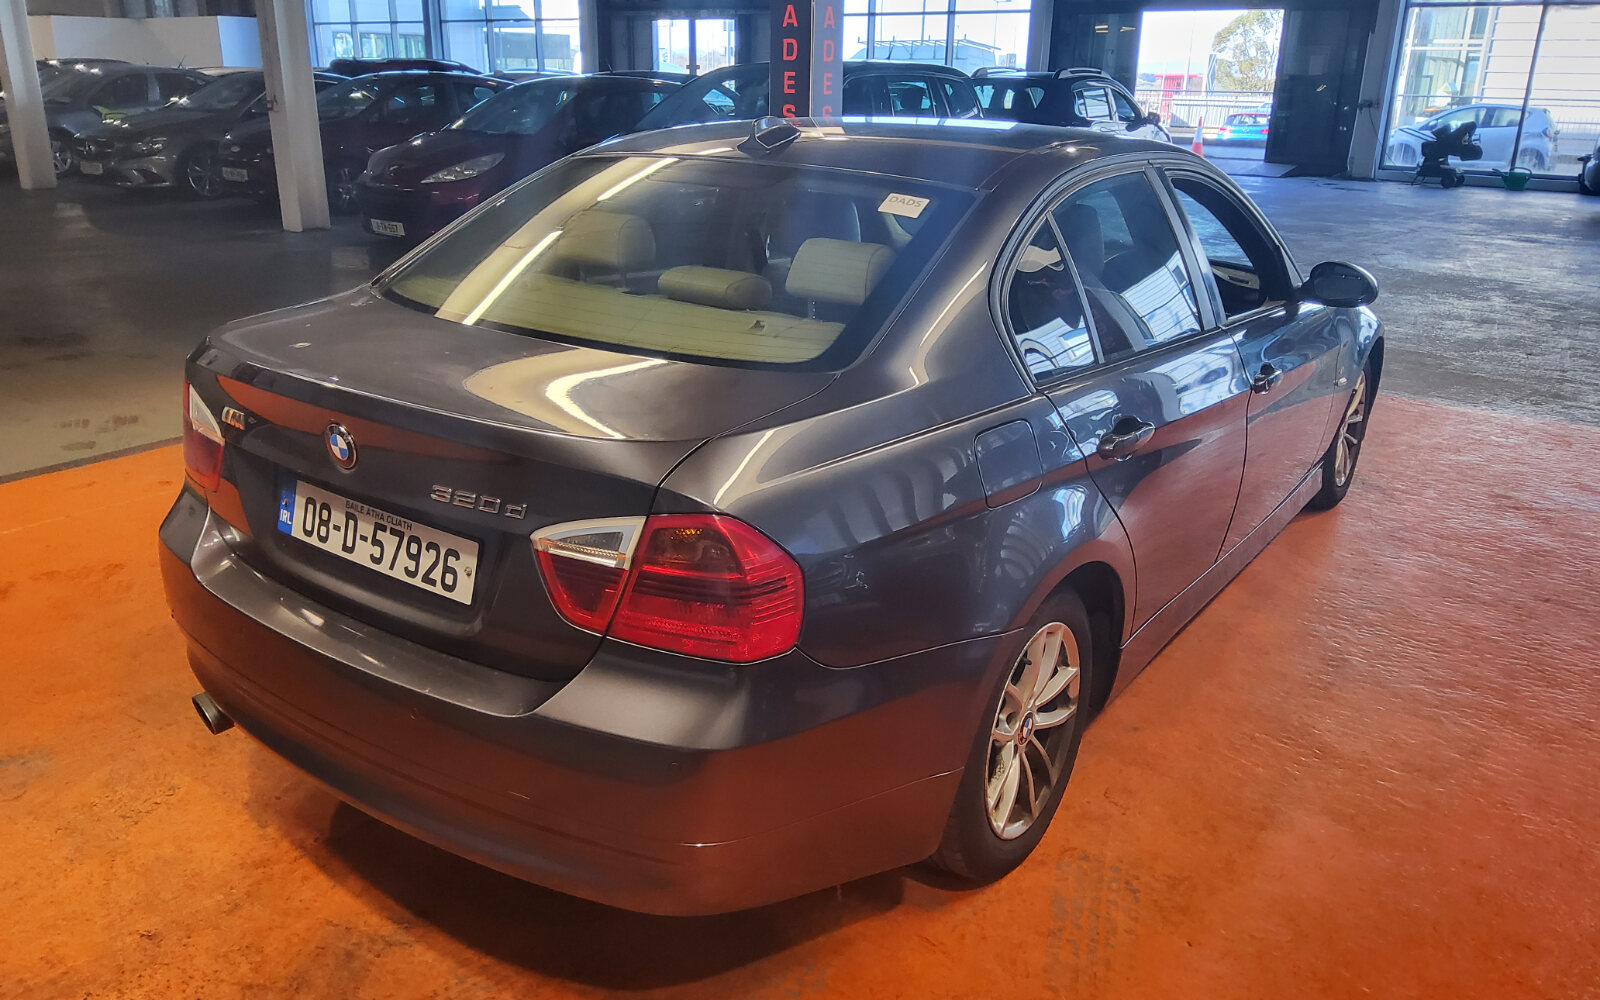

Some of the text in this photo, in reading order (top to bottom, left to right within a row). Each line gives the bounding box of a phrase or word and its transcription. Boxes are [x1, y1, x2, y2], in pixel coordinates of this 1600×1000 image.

[888, 196, 924, 208] DADS
[280, 508, 292, 525] IRL
[345, 500, 365, 514] BAILE
[386, 515, 413, 532] CLIATH
[303, 496, 461, 593] 08-D-57926
